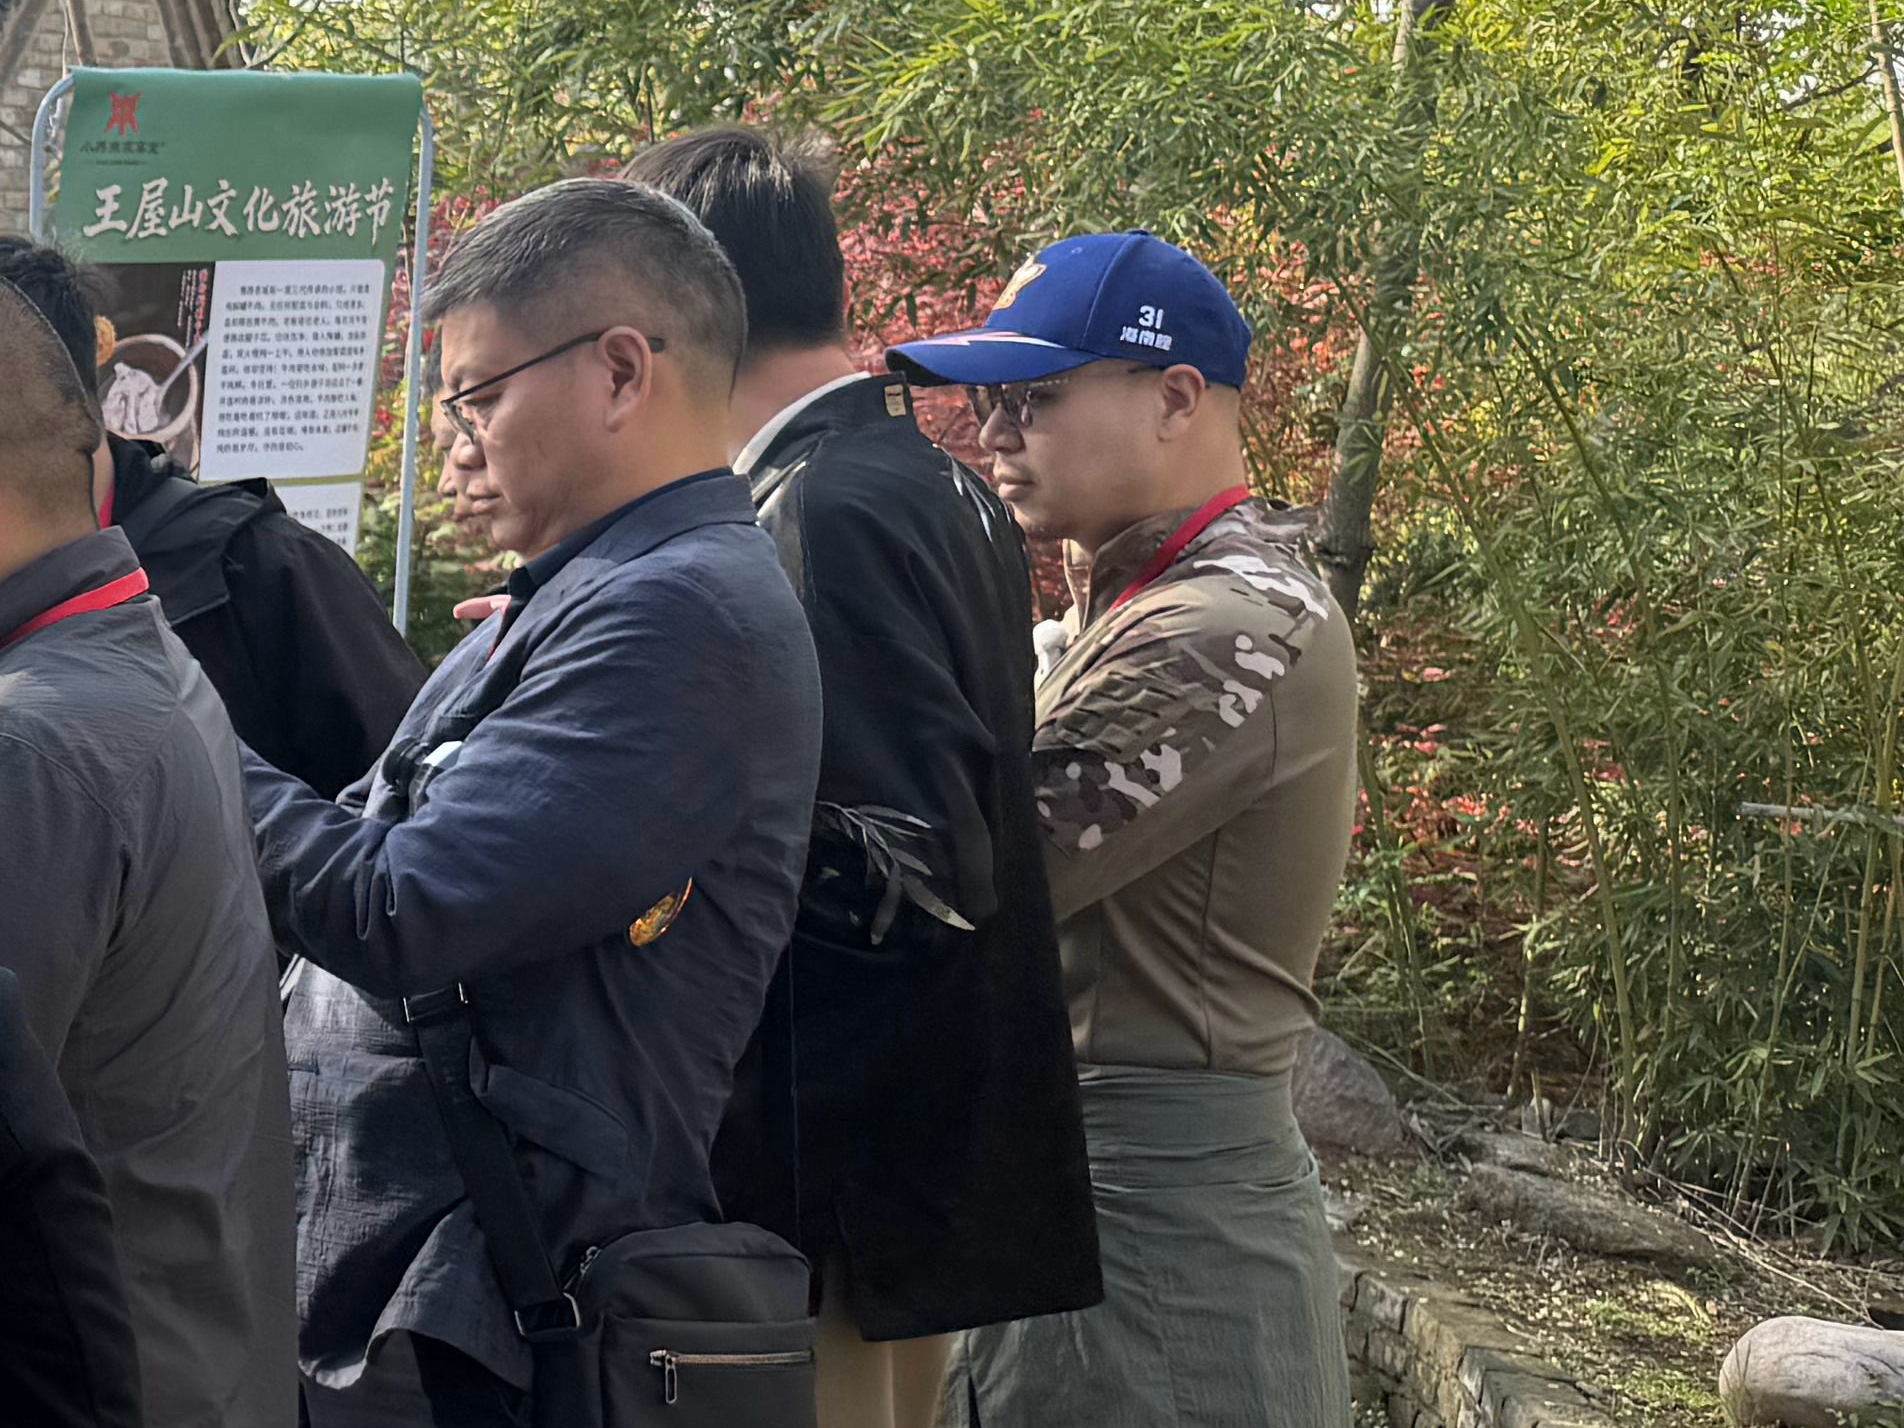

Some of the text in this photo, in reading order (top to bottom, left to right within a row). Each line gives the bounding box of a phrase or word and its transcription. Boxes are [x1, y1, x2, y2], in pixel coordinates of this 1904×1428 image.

[82, 176, 394, 247] 王屋山文化旅游节
[1138, 304, 1164, 330] 31
